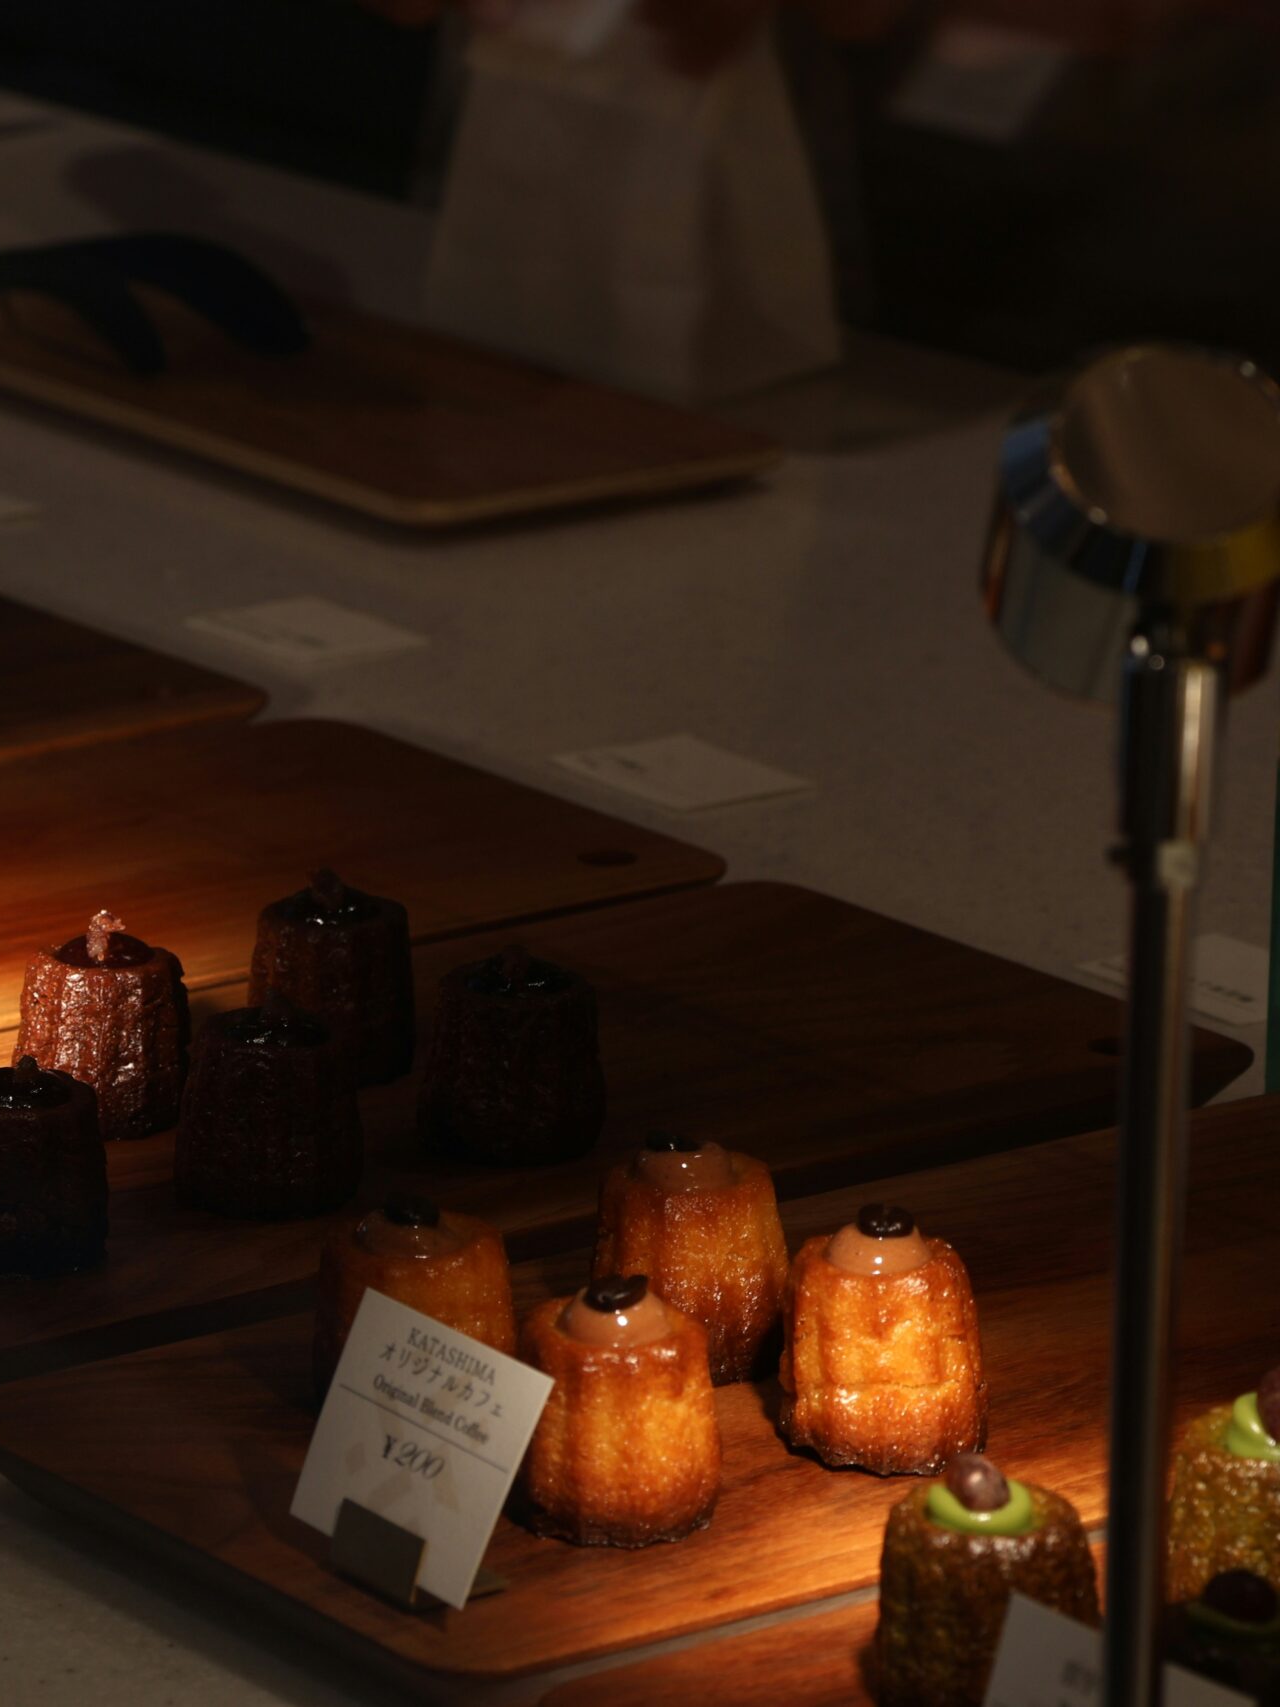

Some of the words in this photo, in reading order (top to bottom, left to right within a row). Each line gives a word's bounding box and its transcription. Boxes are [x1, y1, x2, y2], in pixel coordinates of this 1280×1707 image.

[379, 1342, 502, 1417] オリジナルカフェ
[407, 1327, 495, 1386] KATASHIMA
[373, 1374, 420, 1408] Original
[420, 1397, 454, 1426] Blend
[455, 1416, 489, 1445] Coffee
[381, 1434, 445, 1479] ¥200
